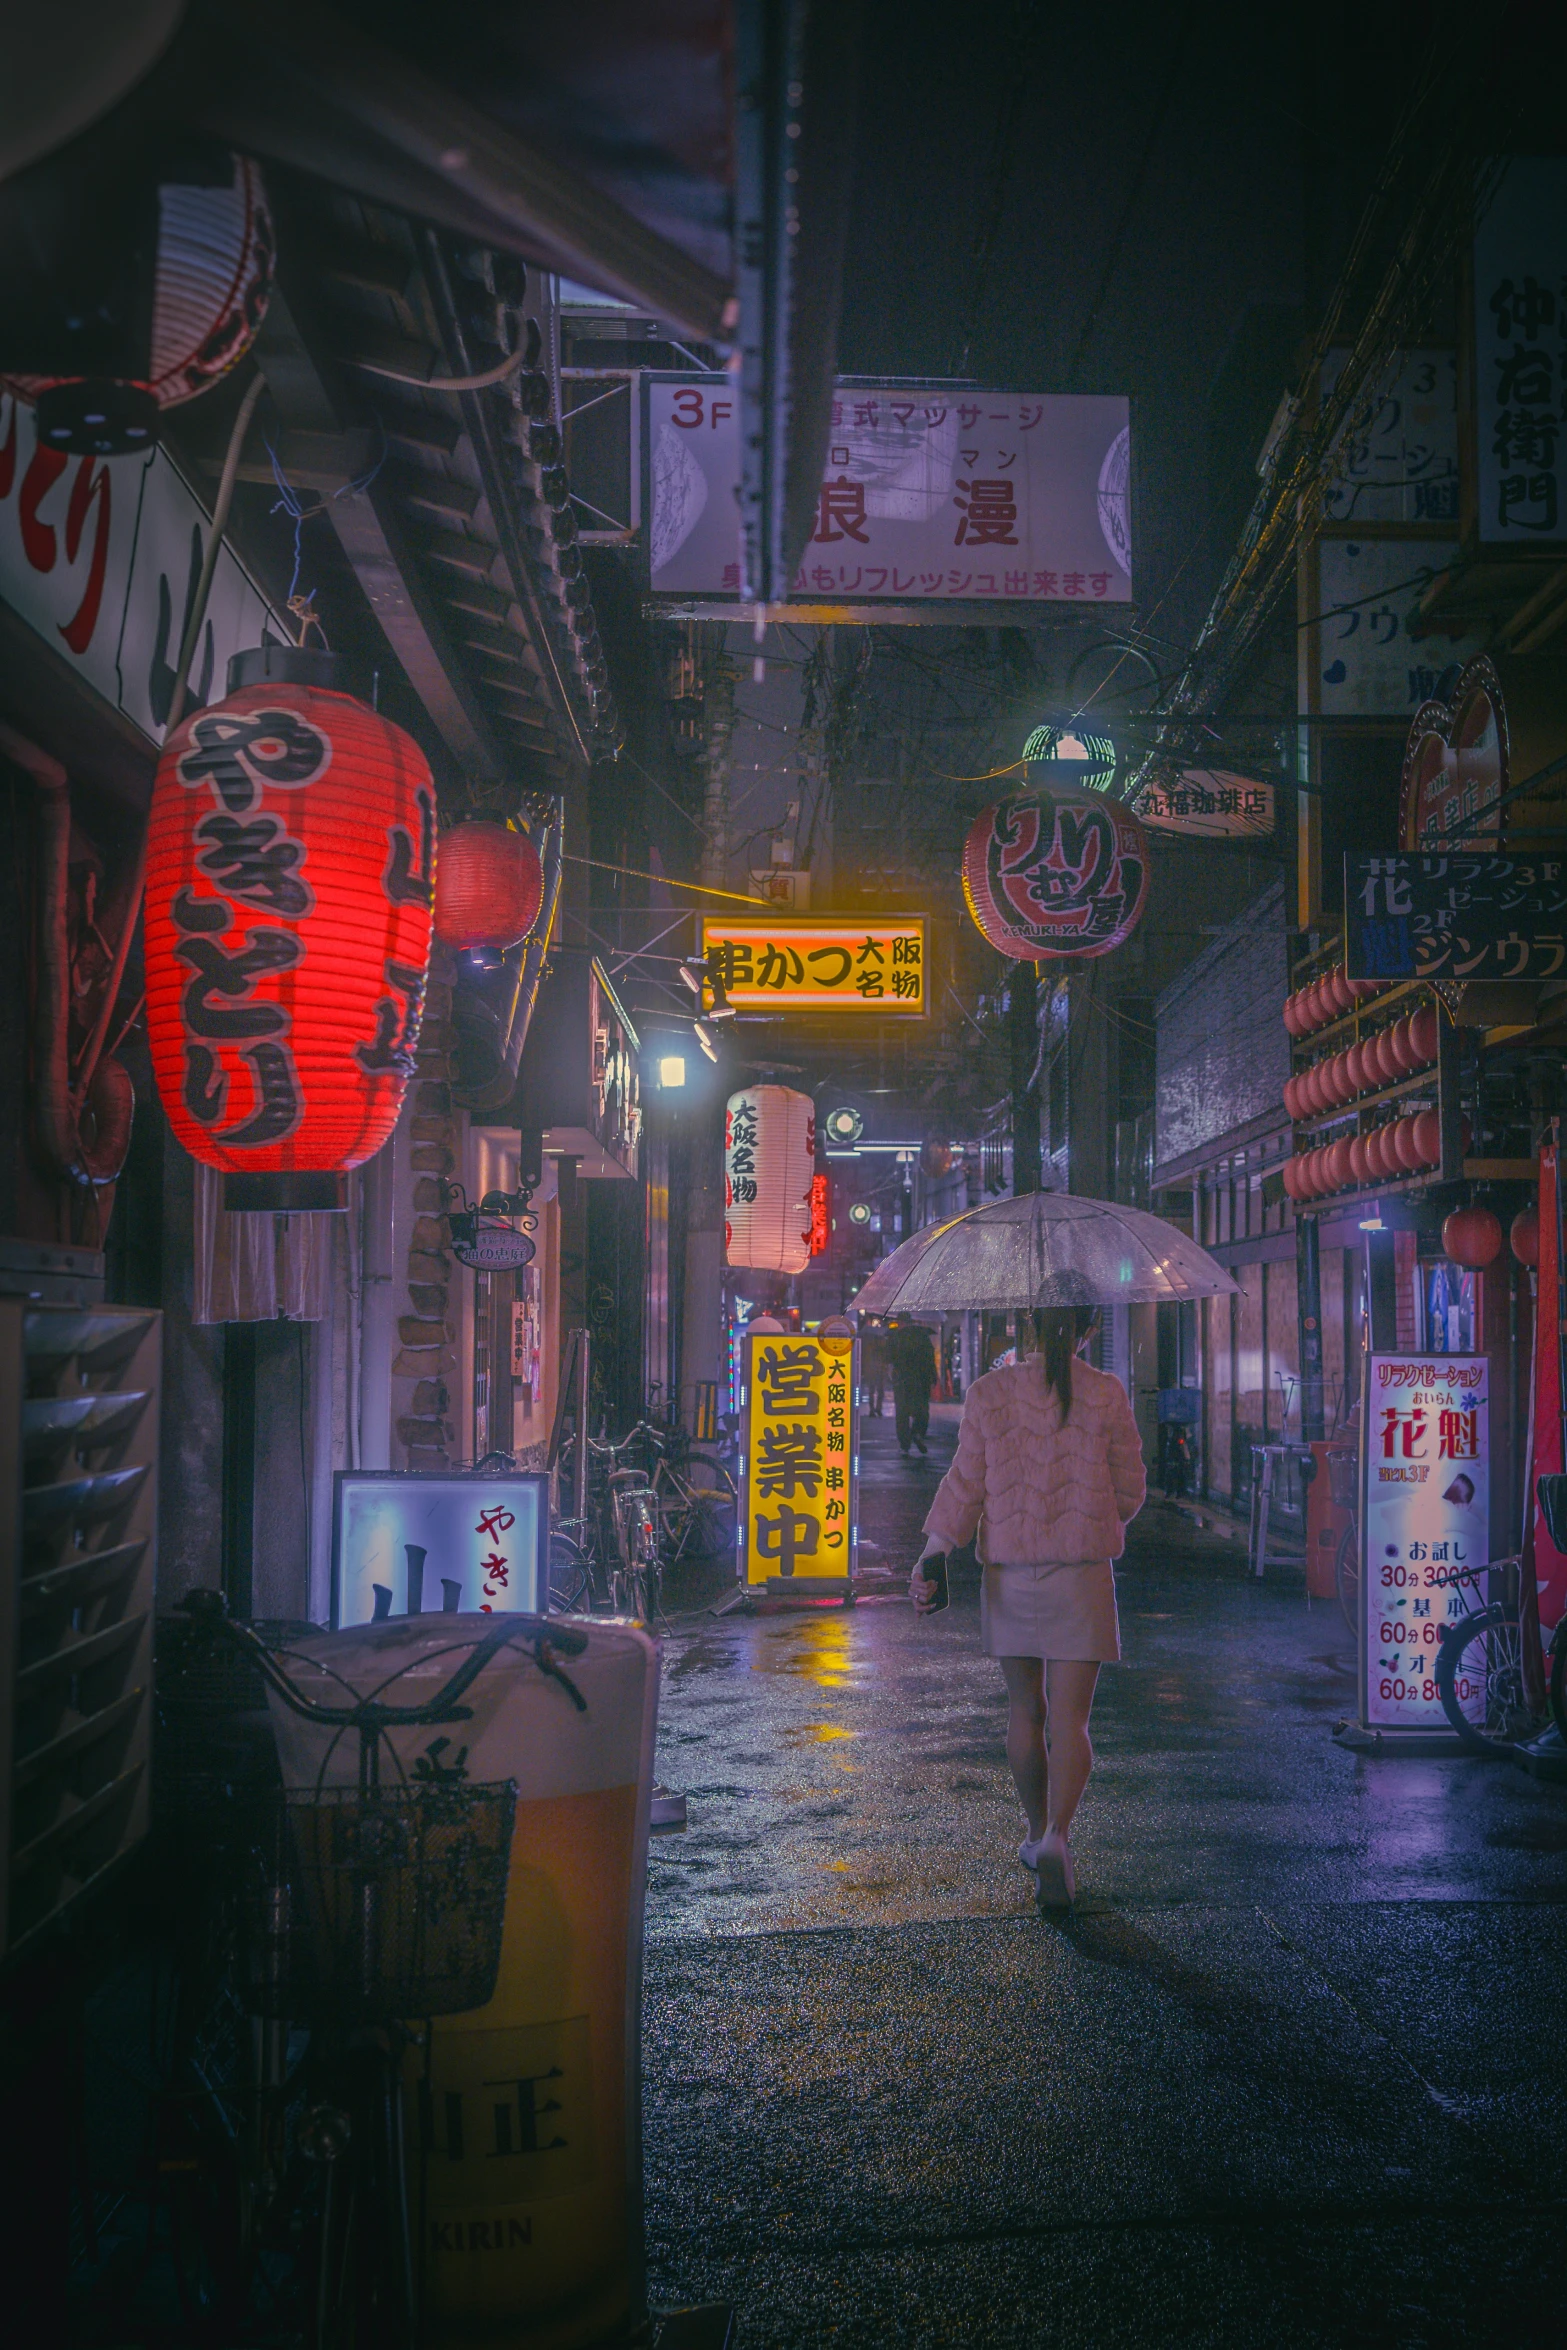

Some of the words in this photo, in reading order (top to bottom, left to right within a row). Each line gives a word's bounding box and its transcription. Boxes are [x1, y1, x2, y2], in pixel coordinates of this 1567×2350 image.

[671, 388, 733, 429] 3F
[1490, 276, 1560, 531] 仲右衛門
[1423, 857, 1514, 880] リラク
[1515, 861, 1562, 886] 3F
[1443, 886, 1567, 911] ゼーション
[173, 707, 333, 1147] やきとり
[1001, 924, 1080, 938] KEMURI-YA
[1412, 908, 1457, 934] 2F
[707, 939, 853, 991] 串かつ
[856, 936, 922, 965] 大阪
[856, 970, 921, 999] 名物
[730, 1097, 760, 1204] 大阪名物
[1379, 1364, 1483, 1388] リラクゼーション
[826, 1359, 847, 1452] 大阪名物
[1412, 1391, 1455, 1405] おいらん
[1379, 1407, 1480, 1460] 花魁
[755, 1343, 826, 1577] 営業中
[823, 1466, 846, 1549] 串かつ
[475, 1505, 516, 1614] やき
[1409, 1541, 1468, 1562] お試し
[1380, 1565, 1419, 1588] 30分
[1412, 1597, 1464, 1618] 基本
[1380, 1621, 1419, 1644] 60分
[1379, 1678, 1418, 1700] 60分
[429, 2216, 534, 2252] KIRIN
